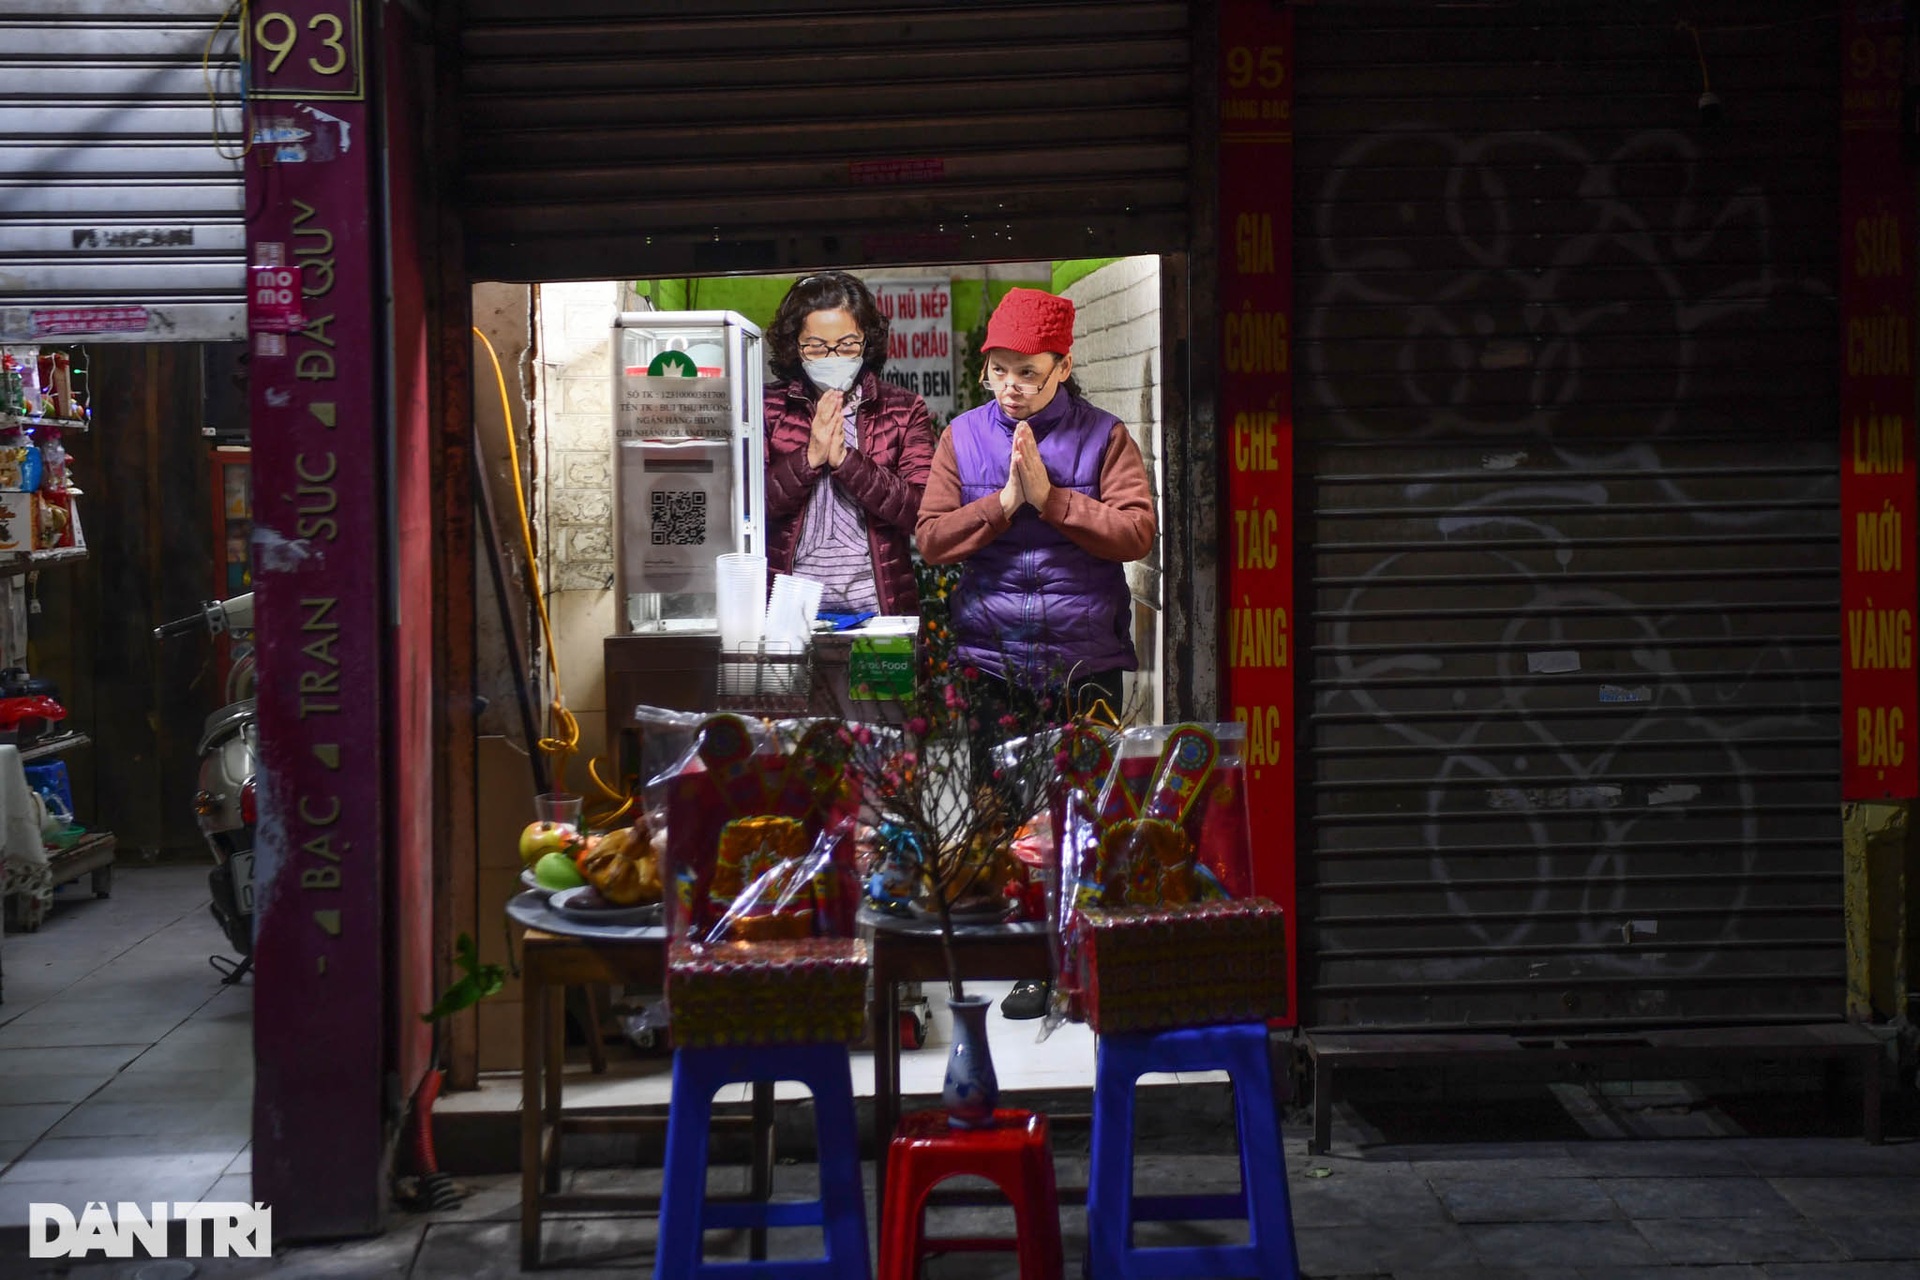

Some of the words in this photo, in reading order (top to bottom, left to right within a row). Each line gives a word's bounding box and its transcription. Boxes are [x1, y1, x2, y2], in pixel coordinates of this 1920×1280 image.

[254, 11, 347, 75] 93
[1226, 46, 1286, 90] 95
[1235, 211, 1275, 275] GIA
[920, 283, 948, 318] NẾP
[1224, 298, 1290, 374] CÔNG
[887, 326, 907, 359] ÂN
[911, 325, 949, 359] CHÂU
[923, 370, 951, 397] ĐEN
[1233, 392, 1281, 472] CHẾ
[1852, 400, 1905, 475] LÀM
[1233, 495, 1279, 571] TÁC
[1856, 498, 1903, 573] MỚI
[1227, 593, 1288, 669] VÀNG
[1848, 595, 1913, 670] VÀNG
[1856, 705, 1905, 781] BẠC
[303, 796, 351, 890] BẠC
